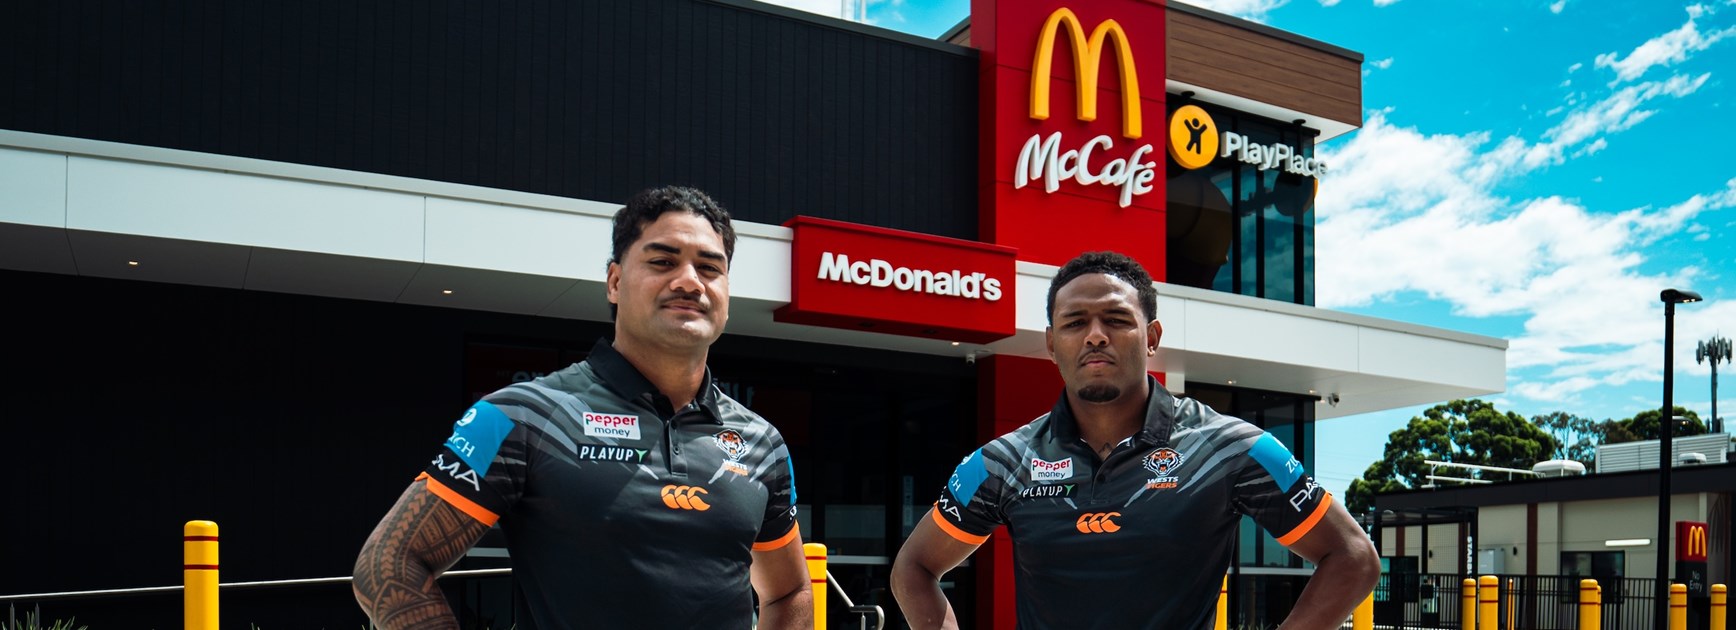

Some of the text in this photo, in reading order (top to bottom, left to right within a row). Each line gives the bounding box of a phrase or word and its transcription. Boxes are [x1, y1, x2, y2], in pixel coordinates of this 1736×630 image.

[1221, 131, 1328, 178] PlayPlace
[1015, 131, 1156, 208] McCafé
[817, 251, 1002, 301] McDonald's
[585, 413, 637, 428] pepper
[594, 426, 631, 438] money
[580, 445, 634, 462] PLAYUP
[1032, 459, 1071, 471] pepper
[1037, 471, 1066, 479] money
[1147, 476, 1179, 484] WESTS
[1022, 485, 1063, 498] PLAYUP
